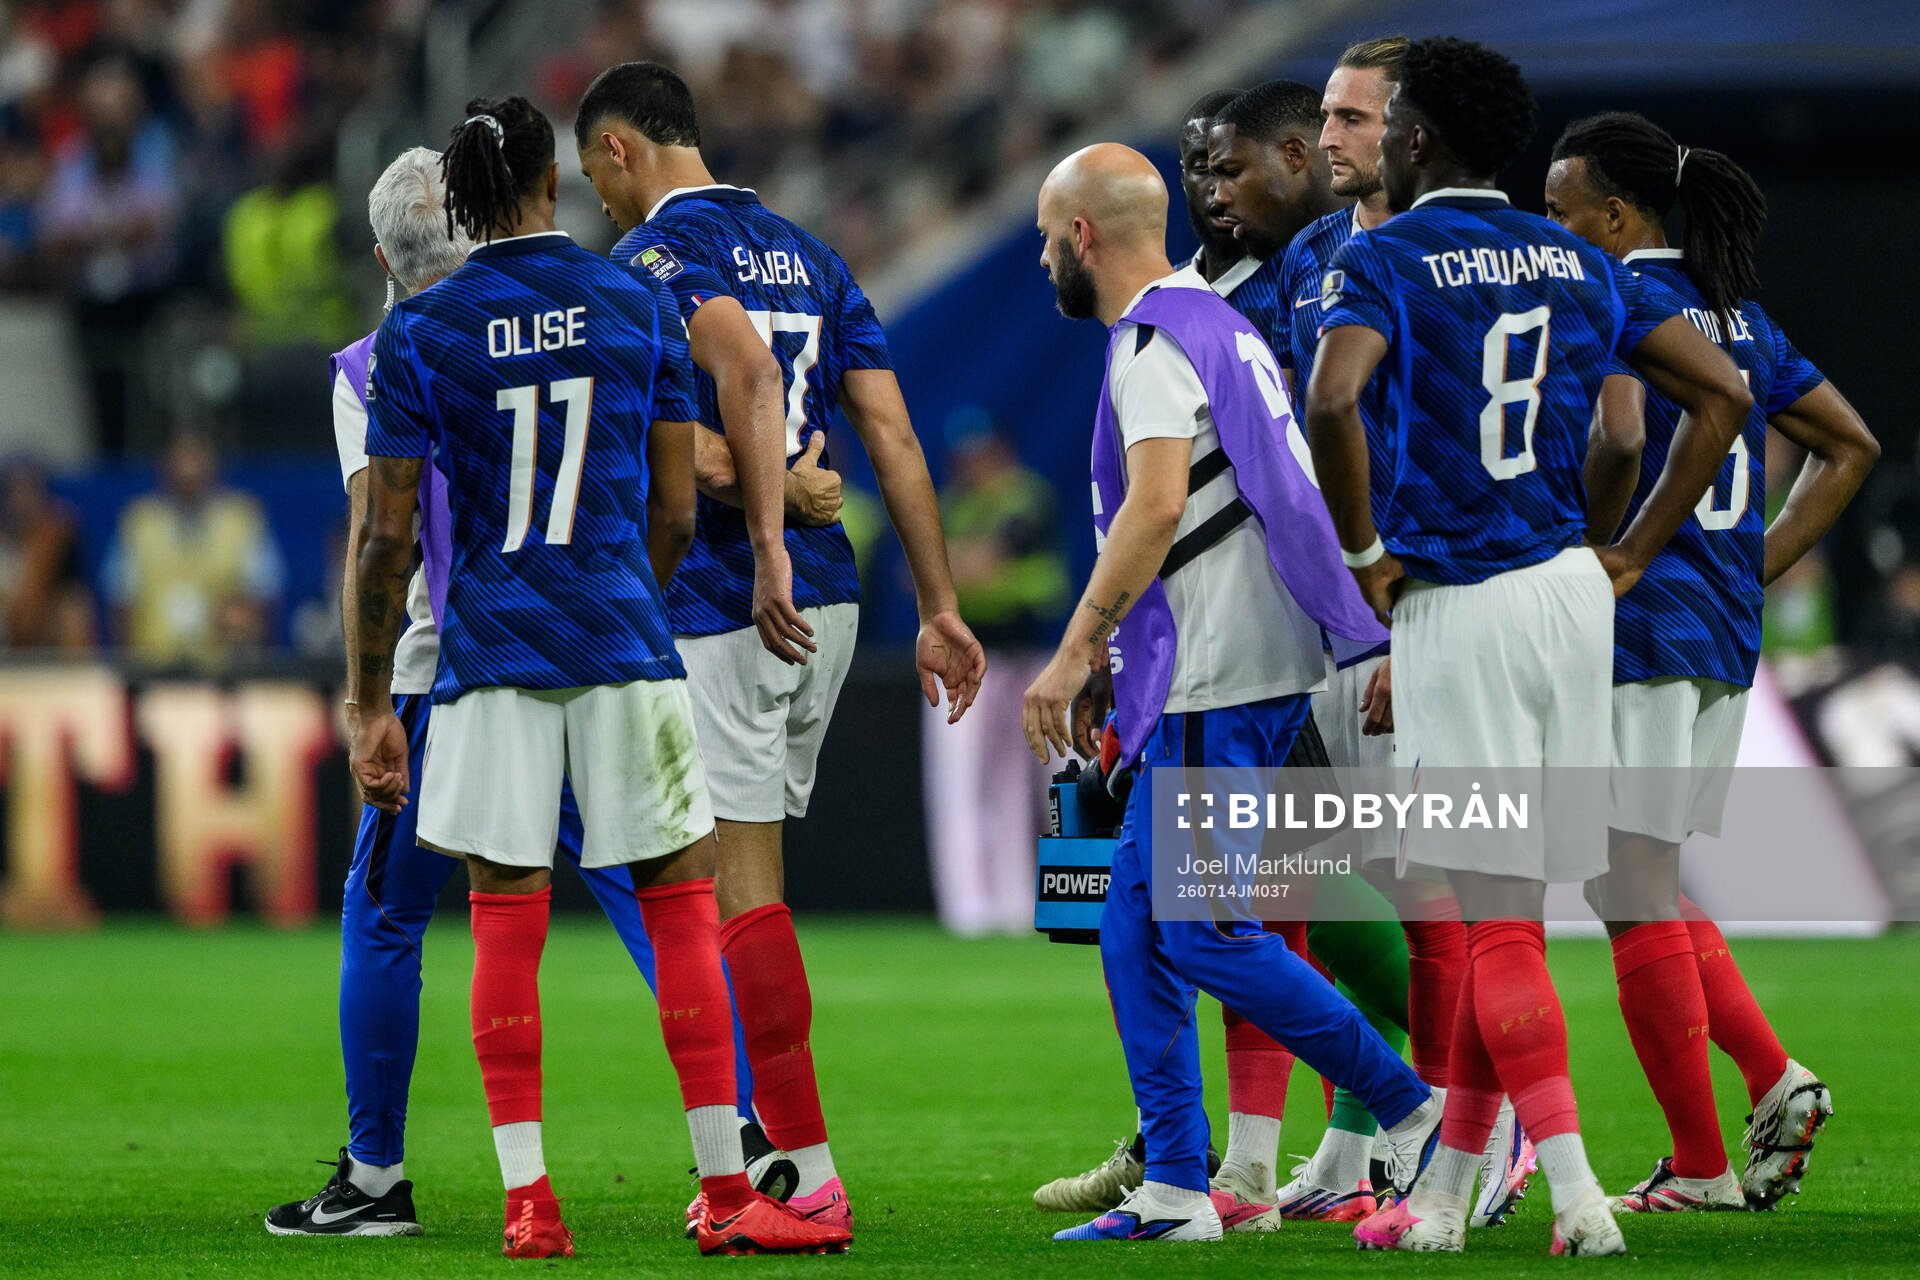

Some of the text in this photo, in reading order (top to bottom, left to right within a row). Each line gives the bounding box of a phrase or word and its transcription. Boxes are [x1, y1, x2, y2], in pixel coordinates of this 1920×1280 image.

[1421, 245, 1585, 288] TCHOUAMENI
[487, 306, 586, 358] OLISE
[1480, 305, 1551, 481] 8
[490, 1015, 534, 1029] FFF
[662, 1008, 702, 1021] FFF
[1501, 1006, 1552, 1035] FFF
